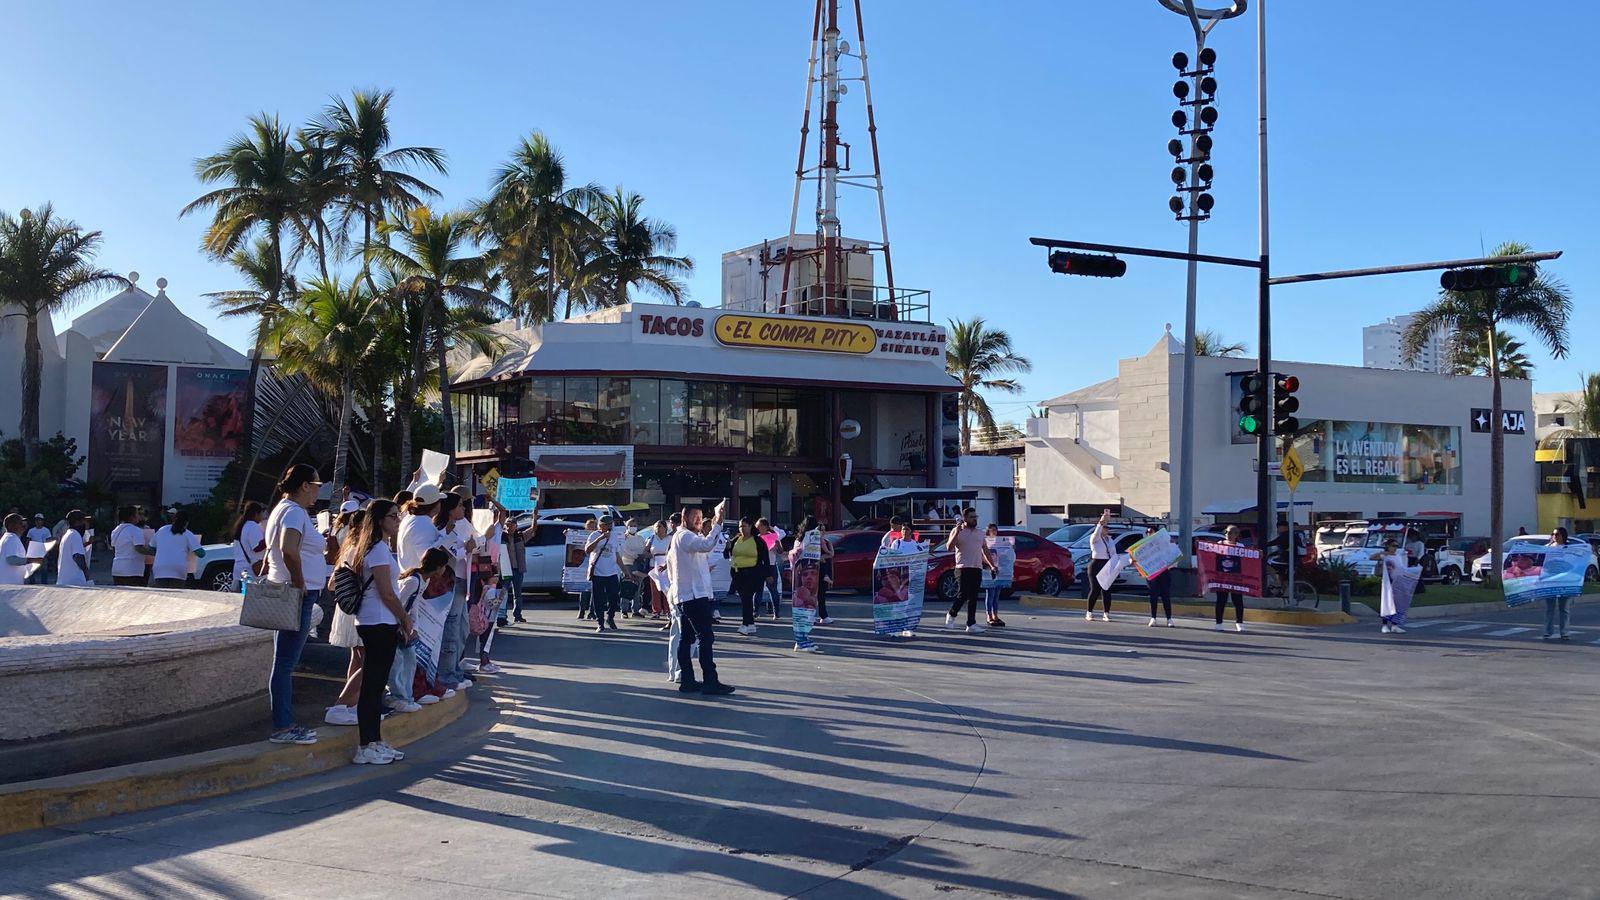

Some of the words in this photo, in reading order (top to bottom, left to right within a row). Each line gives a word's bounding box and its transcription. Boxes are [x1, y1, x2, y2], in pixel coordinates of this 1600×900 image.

[640, 314, 704, 337] TACOS
[733, 320, 752, 339] EL
[758, 322, 816, 344] COMPA
[820, 328, 860, 347] PITY
[875, 328, 946, 343] MAZATLÁN
[880, 342, 940, 356] SINALOA
[1490, 412, 1526, 431] AJA
[108, 429, 147, 441] YEAR
[1336, 440, 1348, 456] LA
[1351, 440, 1400, 457] AVENTURA
[1336, 459, 1348, 475] ES
[1352, 460, 1362, 475] EL
[1365, 460, 1400, 476] REGALO
[1198, 541, 1260, 559] DESAPARECIDO
